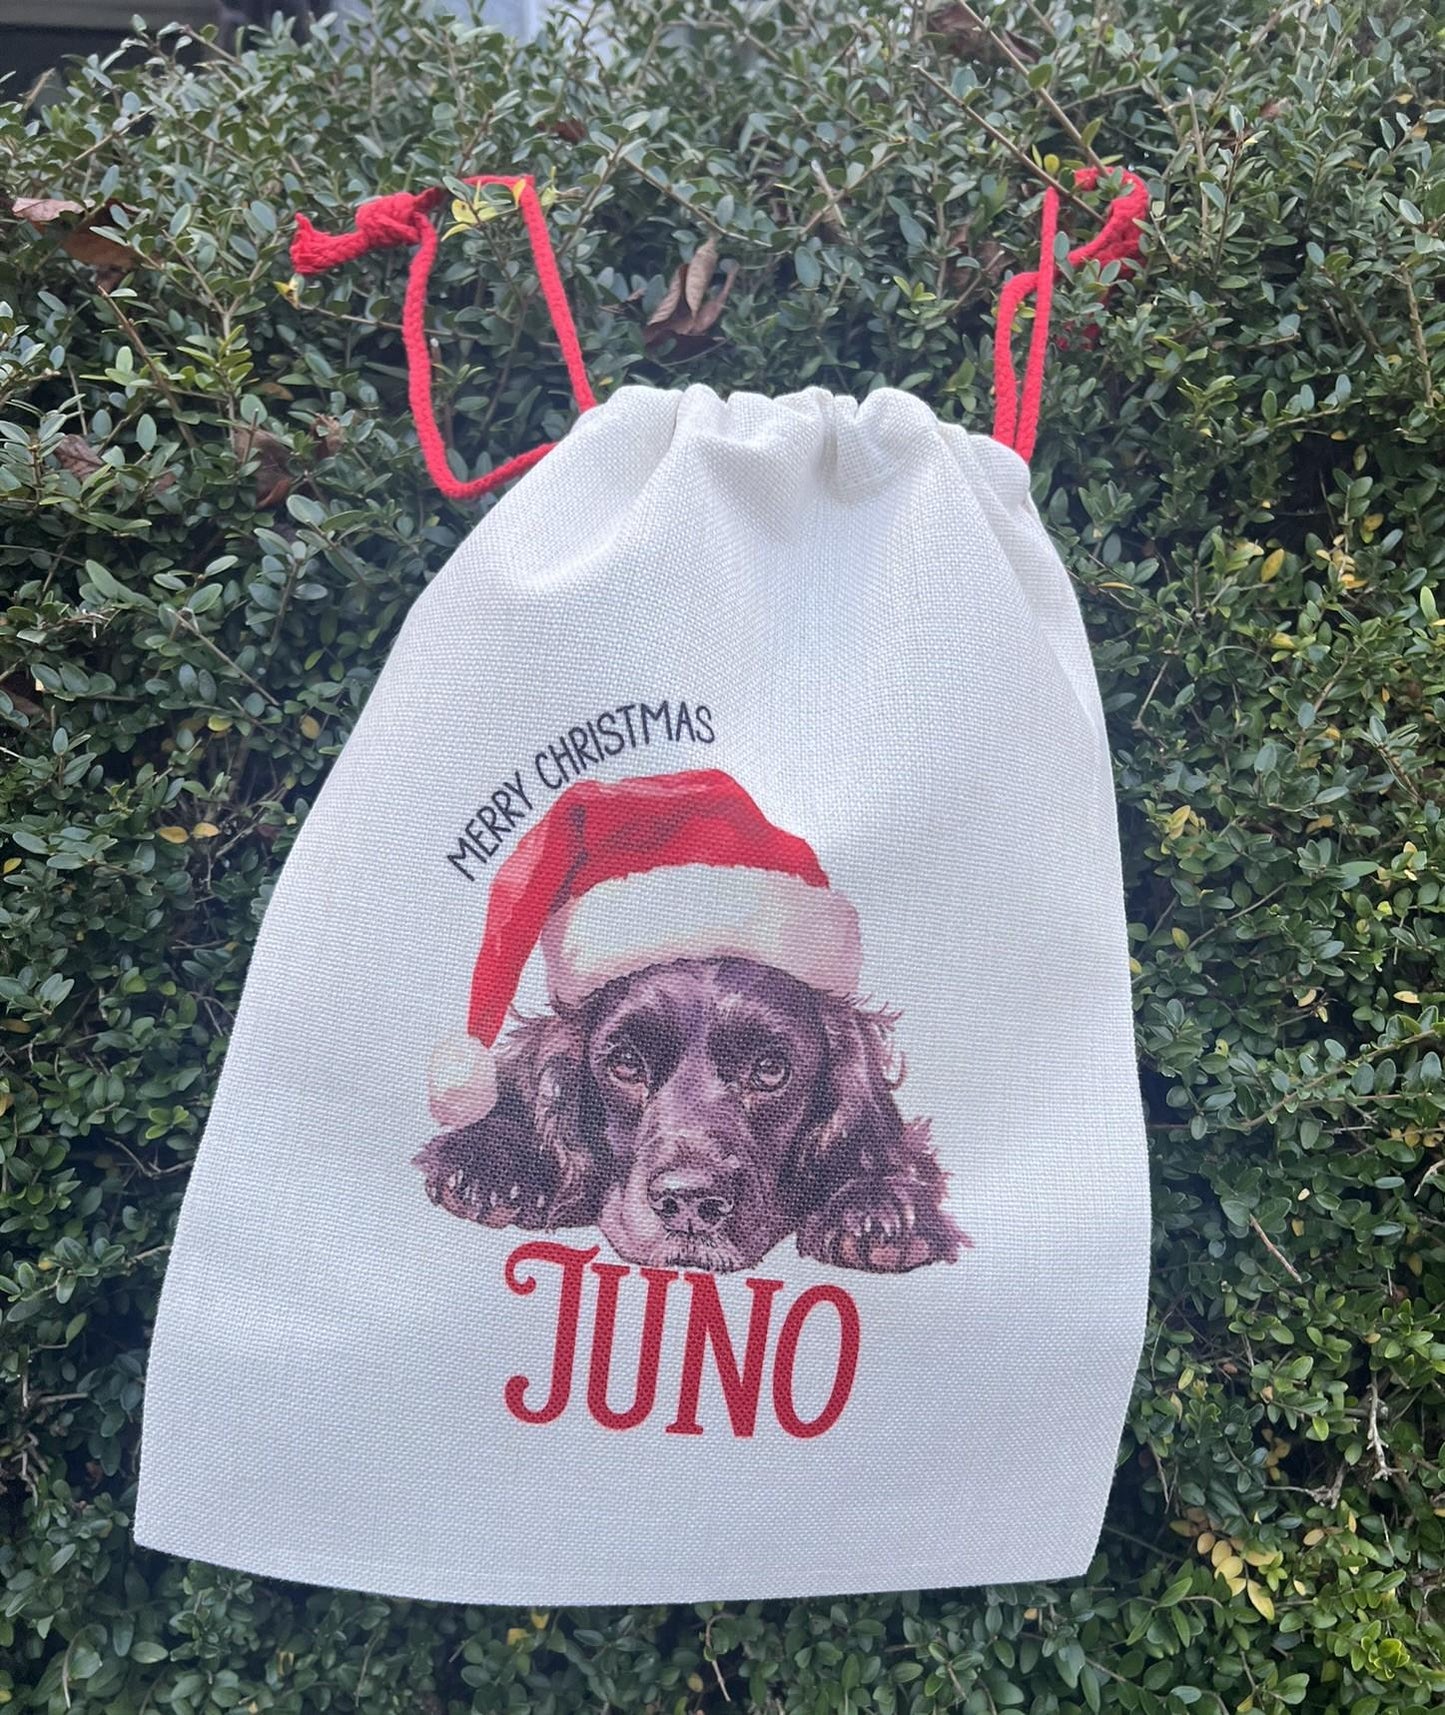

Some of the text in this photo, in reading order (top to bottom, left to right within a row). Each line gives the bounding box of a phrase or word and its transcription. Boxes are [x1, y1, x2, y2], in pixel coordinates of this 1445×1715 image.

[447, 700, 715, 882] MERRY CHRISTMAS
[504, 1241, 860, 1438] JUNO
